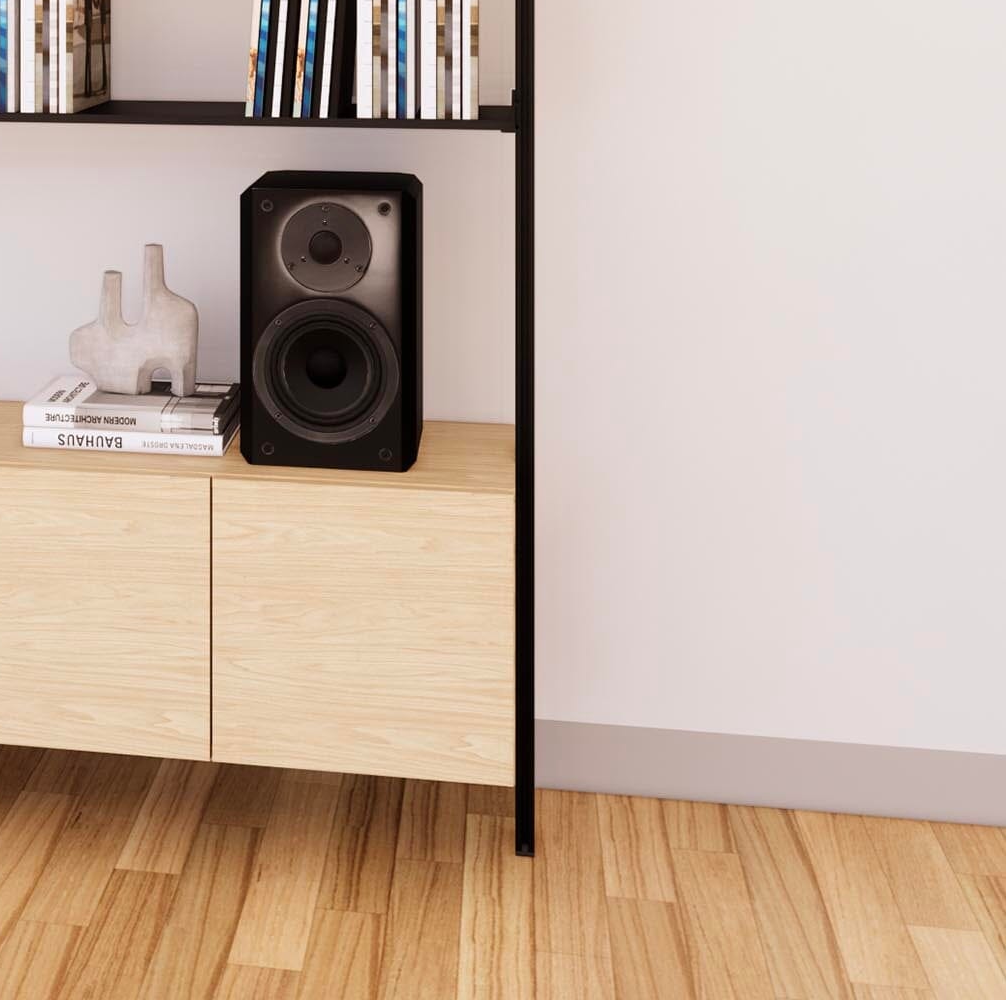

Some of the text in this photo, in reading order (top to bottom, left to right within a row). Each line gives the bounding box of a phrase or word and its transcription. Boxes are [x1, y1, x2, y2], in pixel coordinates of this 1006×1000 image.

[45, 413, 137, 426] MODERN ARCHITECTURE
[57, 433, 123, 449] BAUHAUS
[170, 441, 214, 451] MAGDALENA
